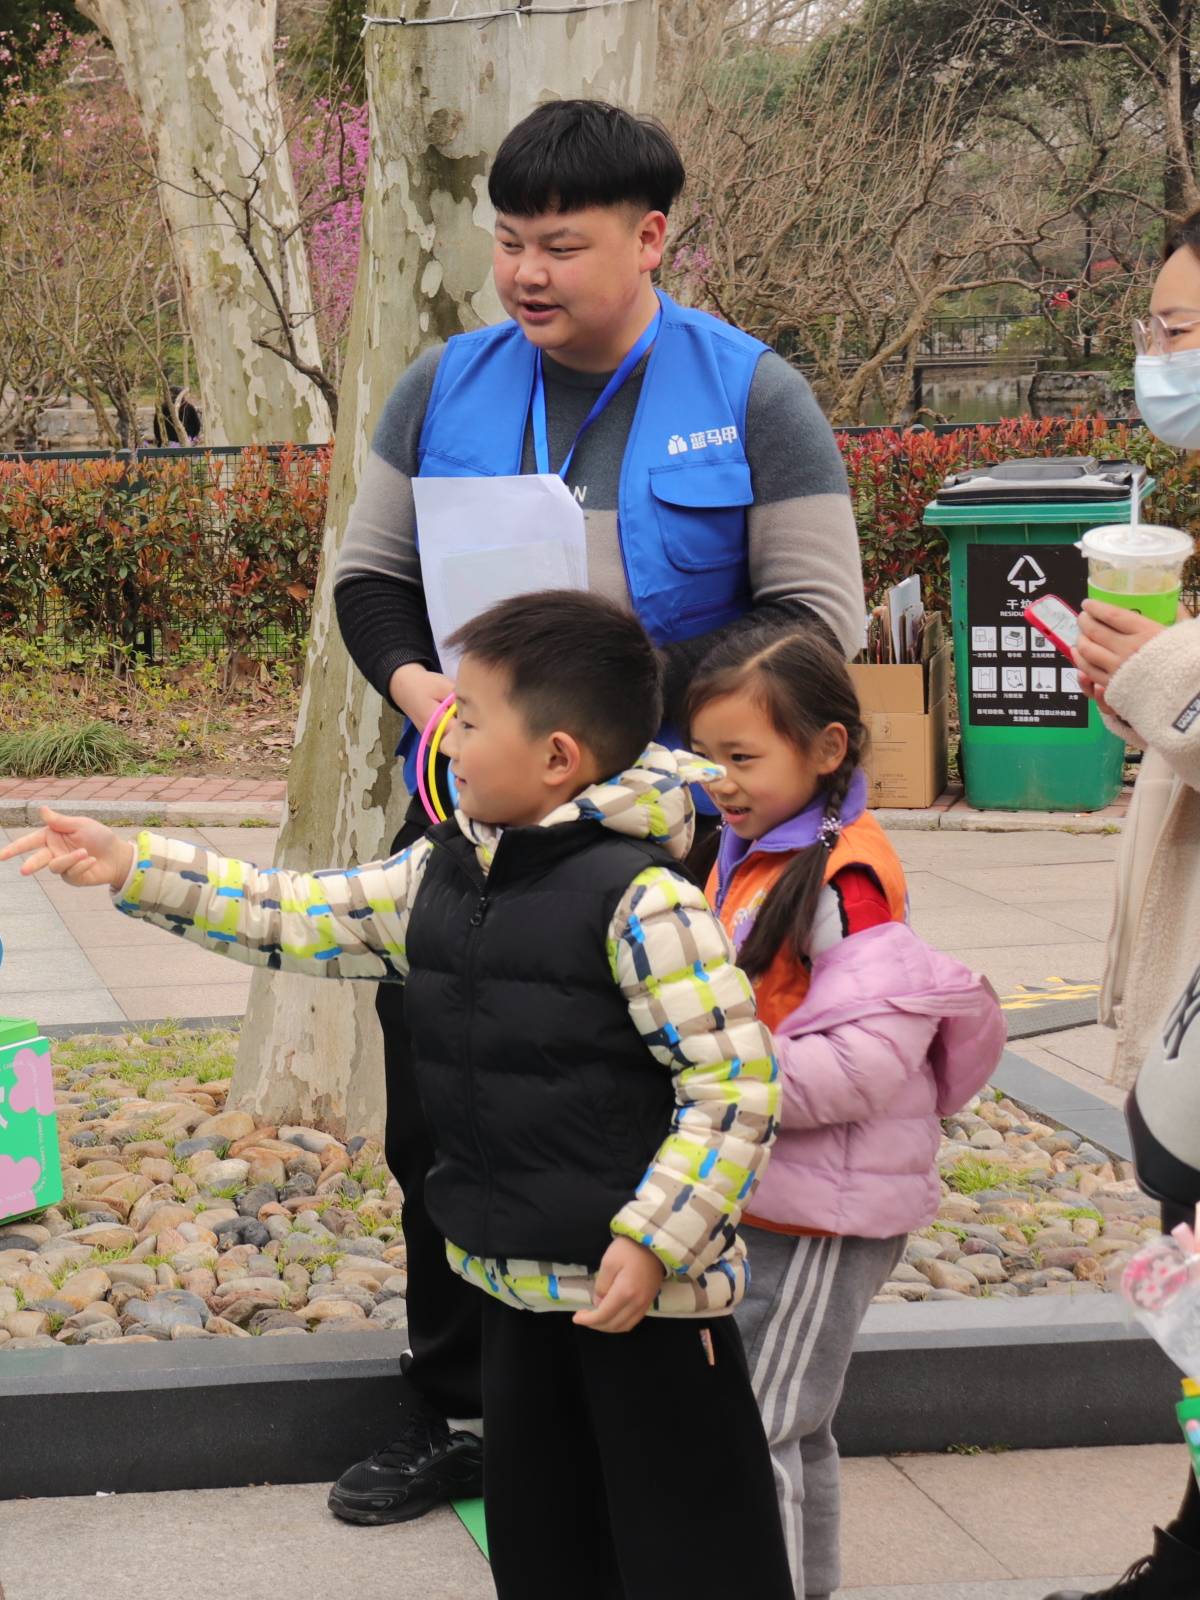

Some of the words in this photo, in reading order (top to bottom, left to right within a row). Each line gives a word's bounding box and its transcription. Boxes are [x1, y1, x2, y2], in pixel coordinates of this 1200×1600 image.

[689, 426, 738, 451] 蓝马甲
[1006, 599, 1034, 610] 干垃
